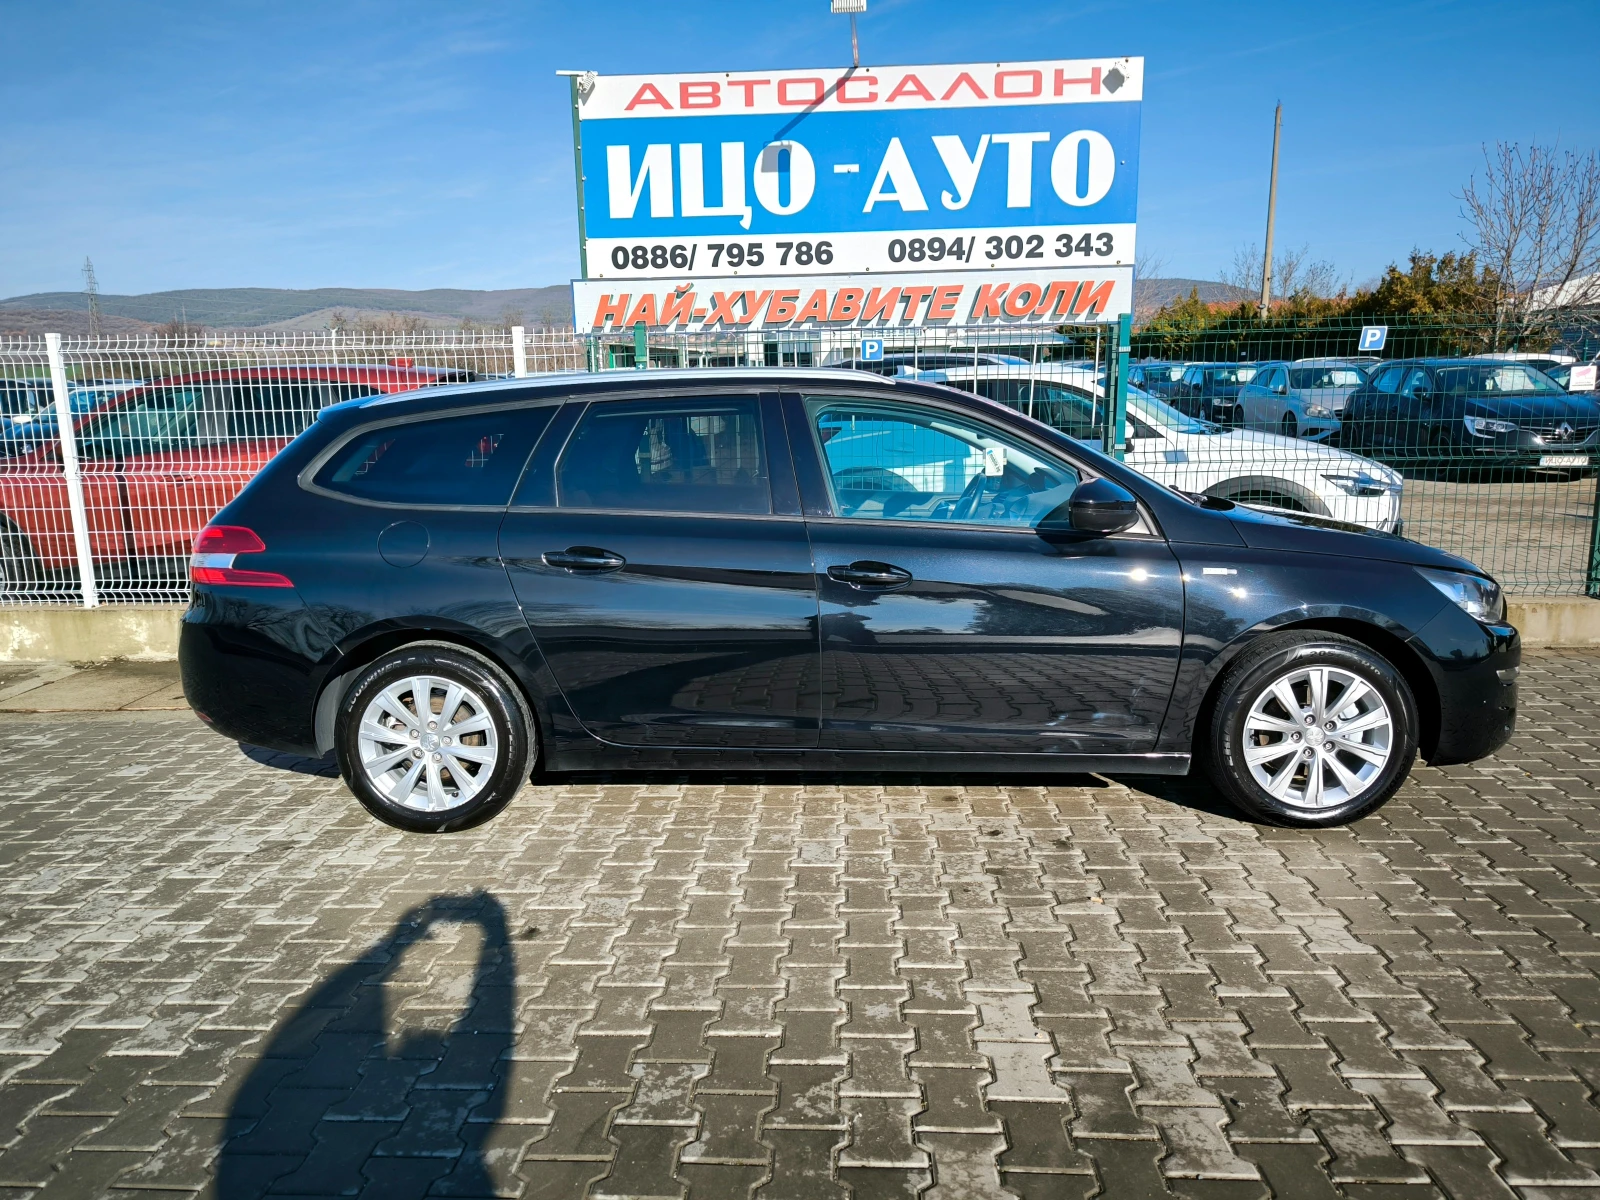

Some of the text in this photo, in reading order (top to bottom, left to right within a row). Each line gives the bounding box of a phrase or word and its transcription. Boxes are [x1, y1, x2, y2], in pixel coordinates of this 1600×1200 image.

[624, 66, 1101, 111] АВТОСАЛОН
[611, 241, 834, 271] 0886/ 795 786
[888, 232, 1114, 263] 0894/ 302 343
[592, 280, 1116, 328] НАЙ-ХУБАВИТЕ КОЛИ
[865, 341, 879, 359] P
[1364, 329, 1381, 348] P
